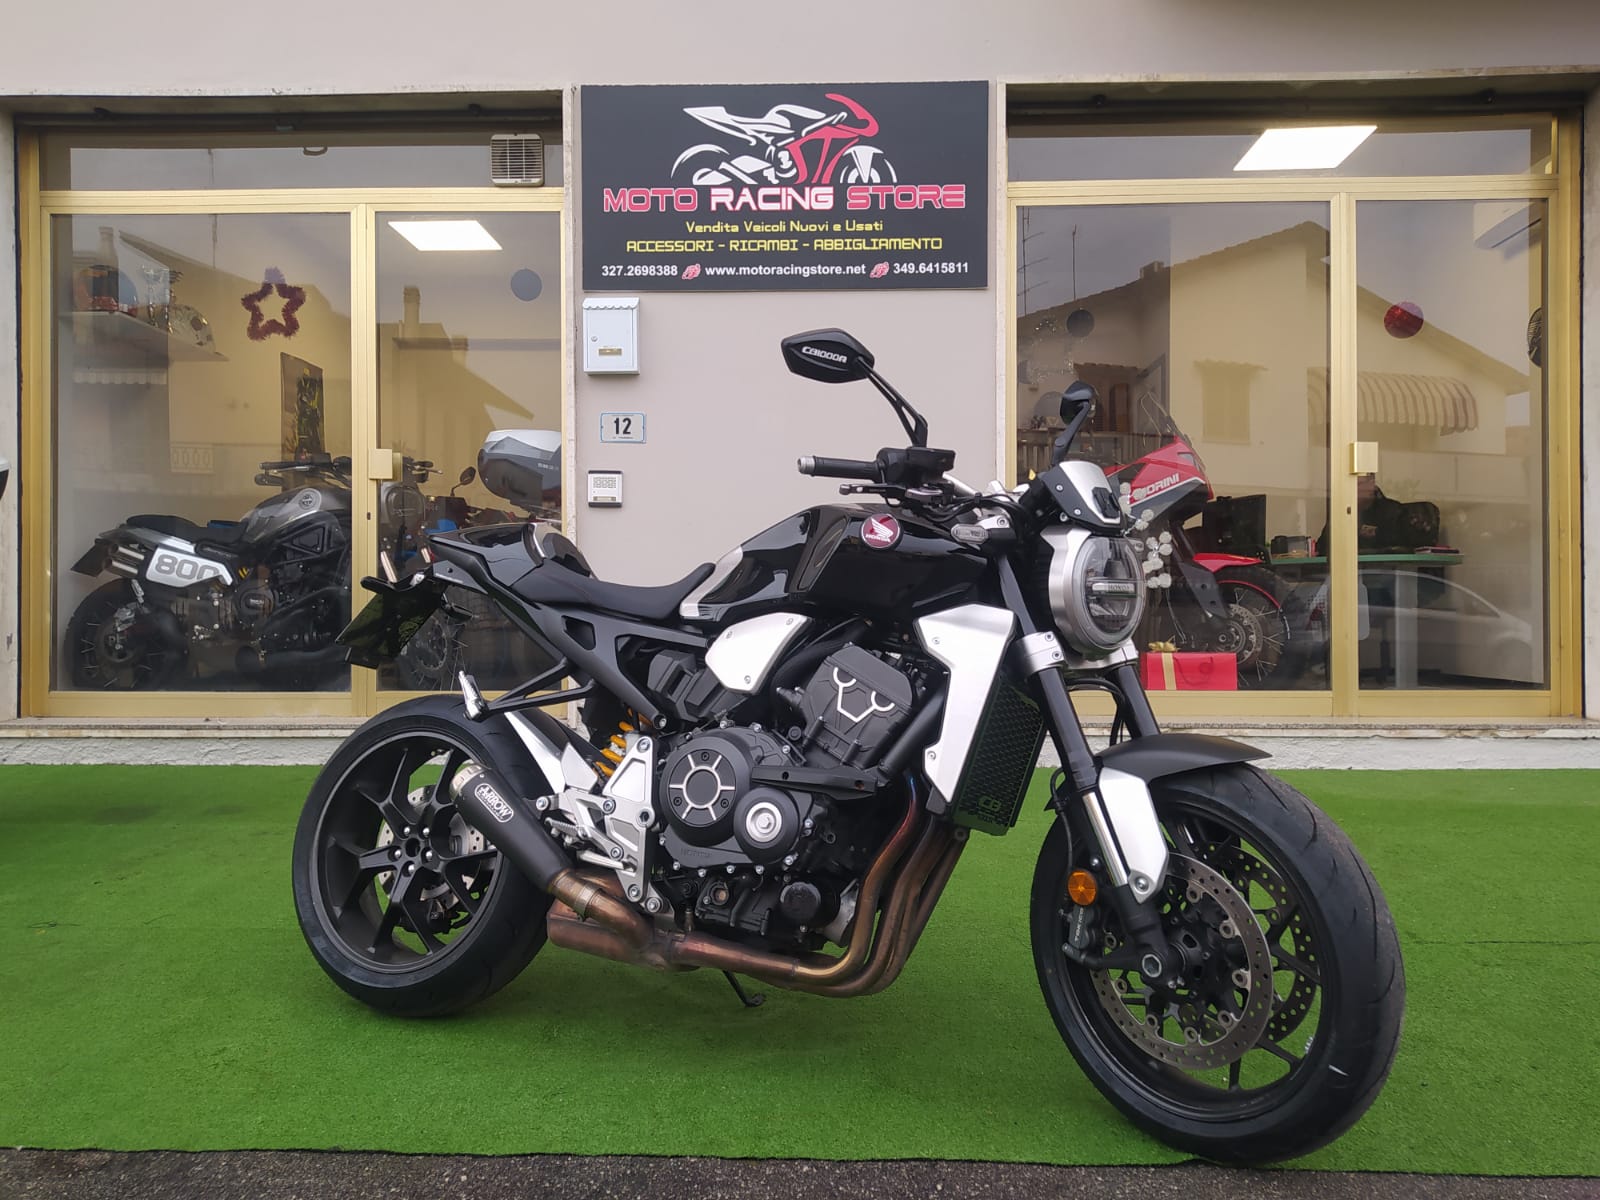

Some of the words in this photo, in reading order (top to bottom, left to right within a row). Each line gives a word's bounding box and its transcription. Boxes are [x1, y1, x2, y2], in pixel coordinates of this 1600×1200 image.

[603, 187, 698, 213] MOTO
[709, 186, 834, 211] RACING
[846, 184, 966, 210] STORE
[685, 220, 740, 233] Vendita
[743, 220, 787, 233] Veicoli
[789, 220, 829, 232] Nuovi
[832, 223, 842, 232] e
[845, 219, 883, 231] Usati
[626, 240, 715, 252] ACCESSORI
[729, 239, 799, 252] RICAMBI
[813, 237, 943, 251] ABBIGLIAMENTO
[601, 265, 678, 277] 327.2698388
[705, 263, 867, 278] www.motoracingstore.net
[893, 262, 969, 275] 349.6415811
[802, 345, 848, 363] CB1000R
[613, 417, 632, 435] 12
[1142, 473, 1180, 496] ORINI
[865, 533, 891, 543] HONDA
[477, 786, 512, 817] ARROW
